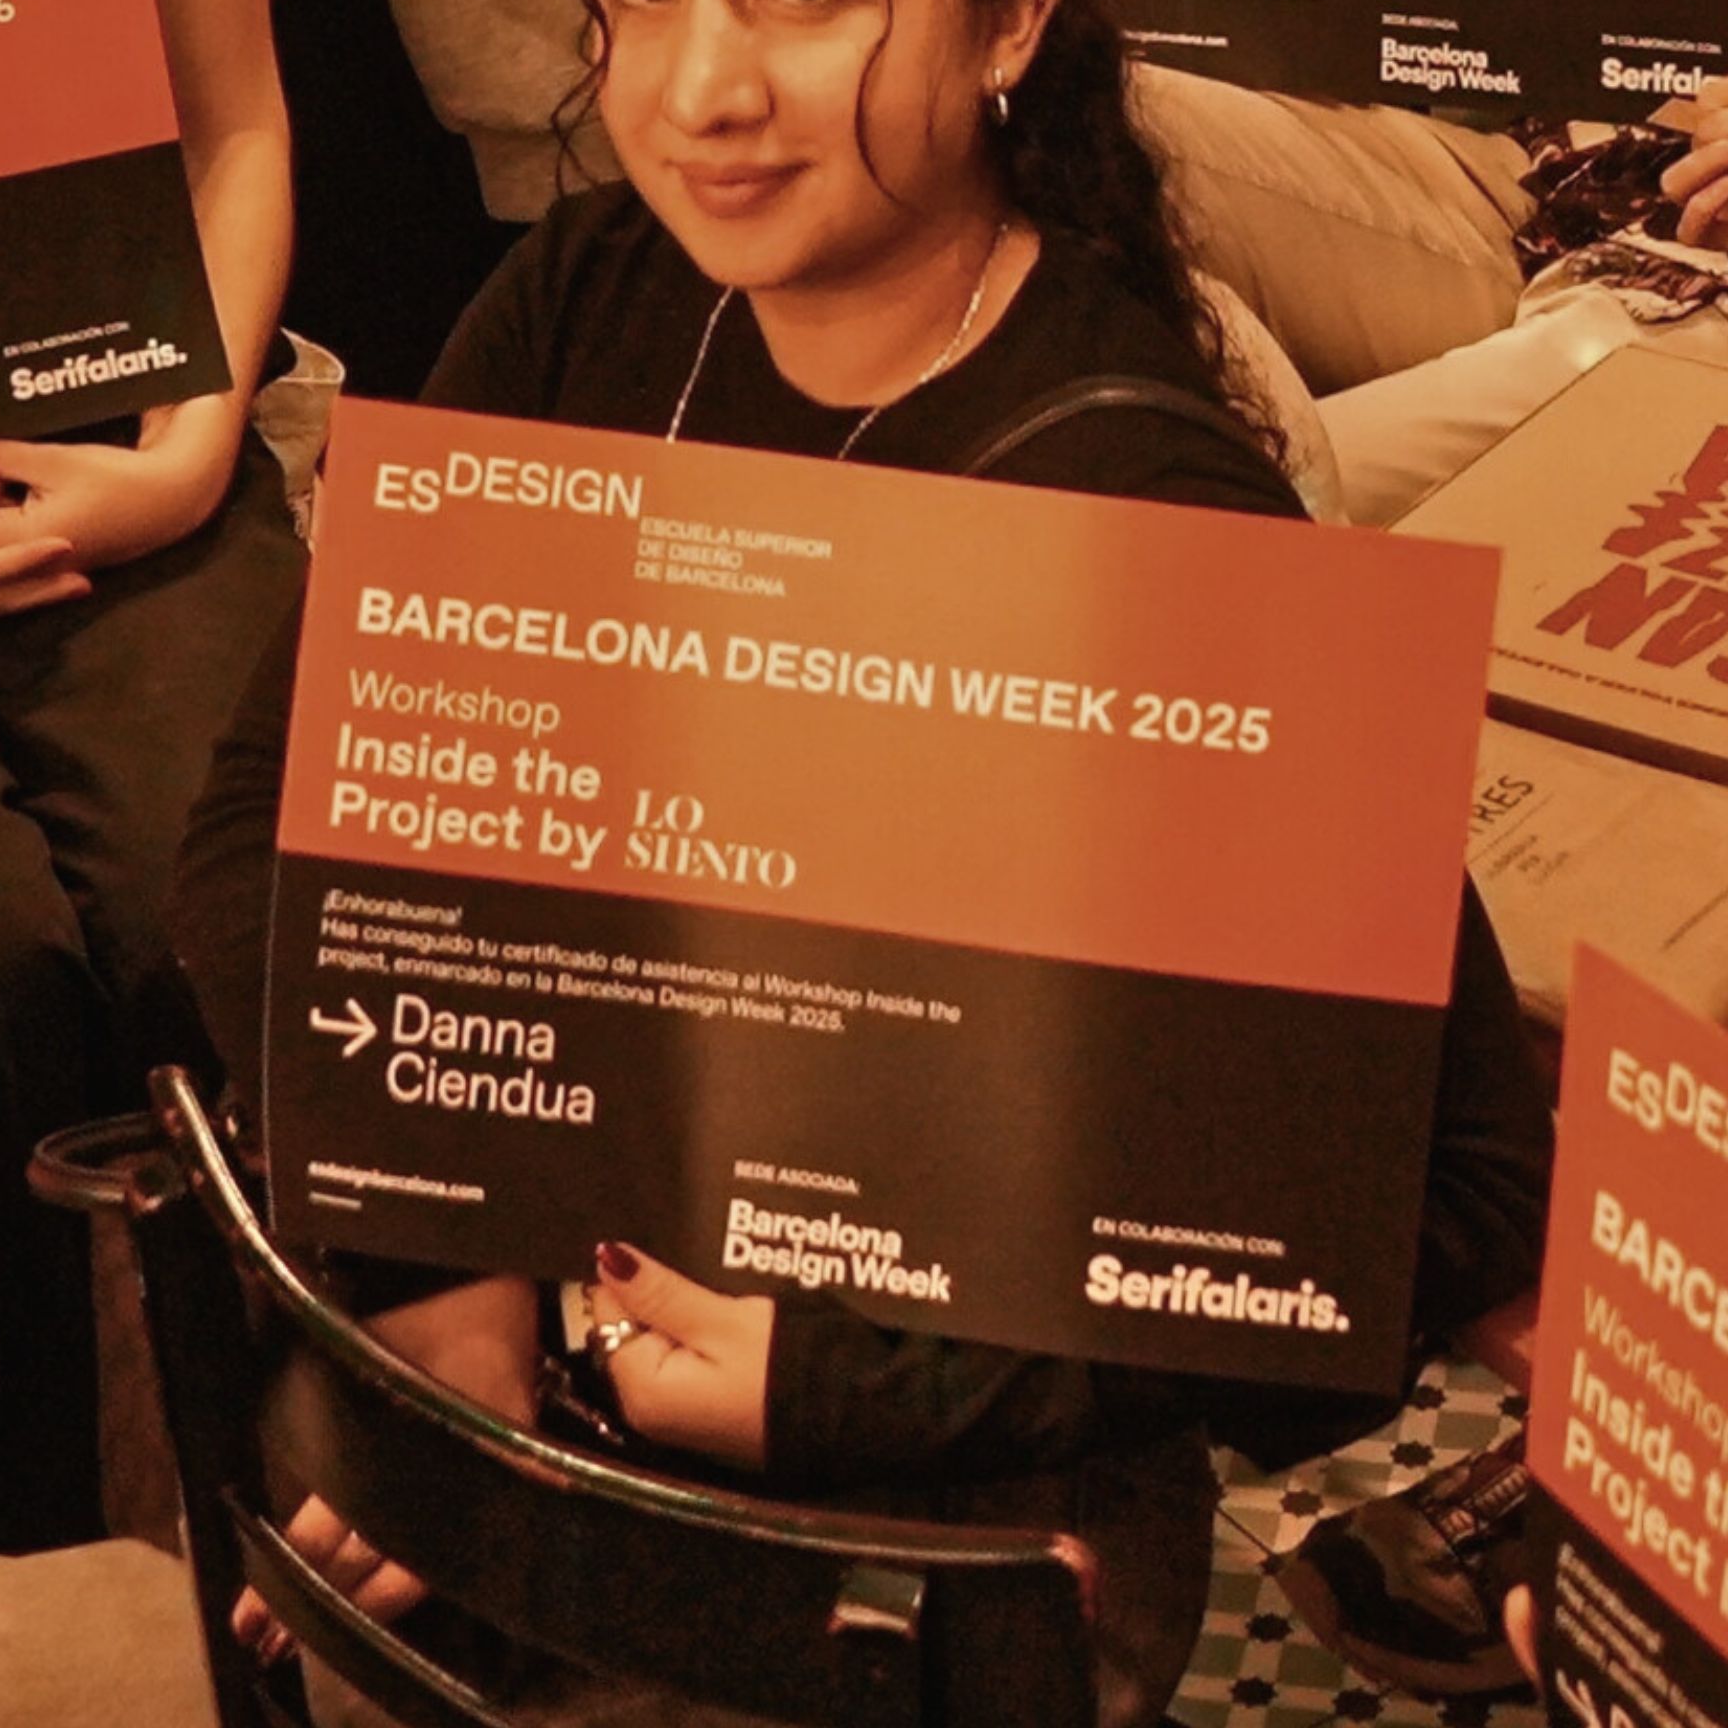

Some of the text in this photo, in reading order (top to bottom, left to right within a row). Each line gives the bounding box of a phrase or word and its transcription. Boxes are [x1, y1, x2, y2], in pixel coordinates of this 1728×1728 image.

[10, 337, 188, 400] Serifalaris.
[374, 451, 643, 519] ESDESIGN
[635, 538, 664, 564] DE
[638, 515, 834, 562] ESCUELA SUPERIOR
[632, 560, 787, 601] DE BARCELONA
[349, 668, 561, 739] Workshop
[357, 587, 1272, 753] BARCELONA DESIGN WEEK 2025
[336, 722, 601, 801] Inside the
[329, 780, 608, 871] Project by
[634, 789, 707, 845] LO
[628, 833, 797, 888] SIENTO
[319, 917, 963, 1025] Has conseguido tu certificado de asistencia al Workshop Inside the
[392, 953, 504, 987] enmarcado
[506, 968, 534, 989] en
[535, 970, 554, 992] la
[556, 972, 656, 1006] Barcelona
[658, 986, 728, 1020] Design
[730, 997, 785, 1024] Week
[392, 993, 555, 1061] Danna
[386, 1051, 595, 1123] Ciendua
[733, 1160, 776, 1183] SEDE
[725, 1198, 902, 1265] Barcelona
[1091, 1215, 1120, 1235] EN
[722, 1229, 951, 1303] Design Week
[1084, 1254, 1350, 1332] Serifalaris.
[1571, 1349, 1695, 1498] Inside
[1563, 1417, 1712, 1596] Project
